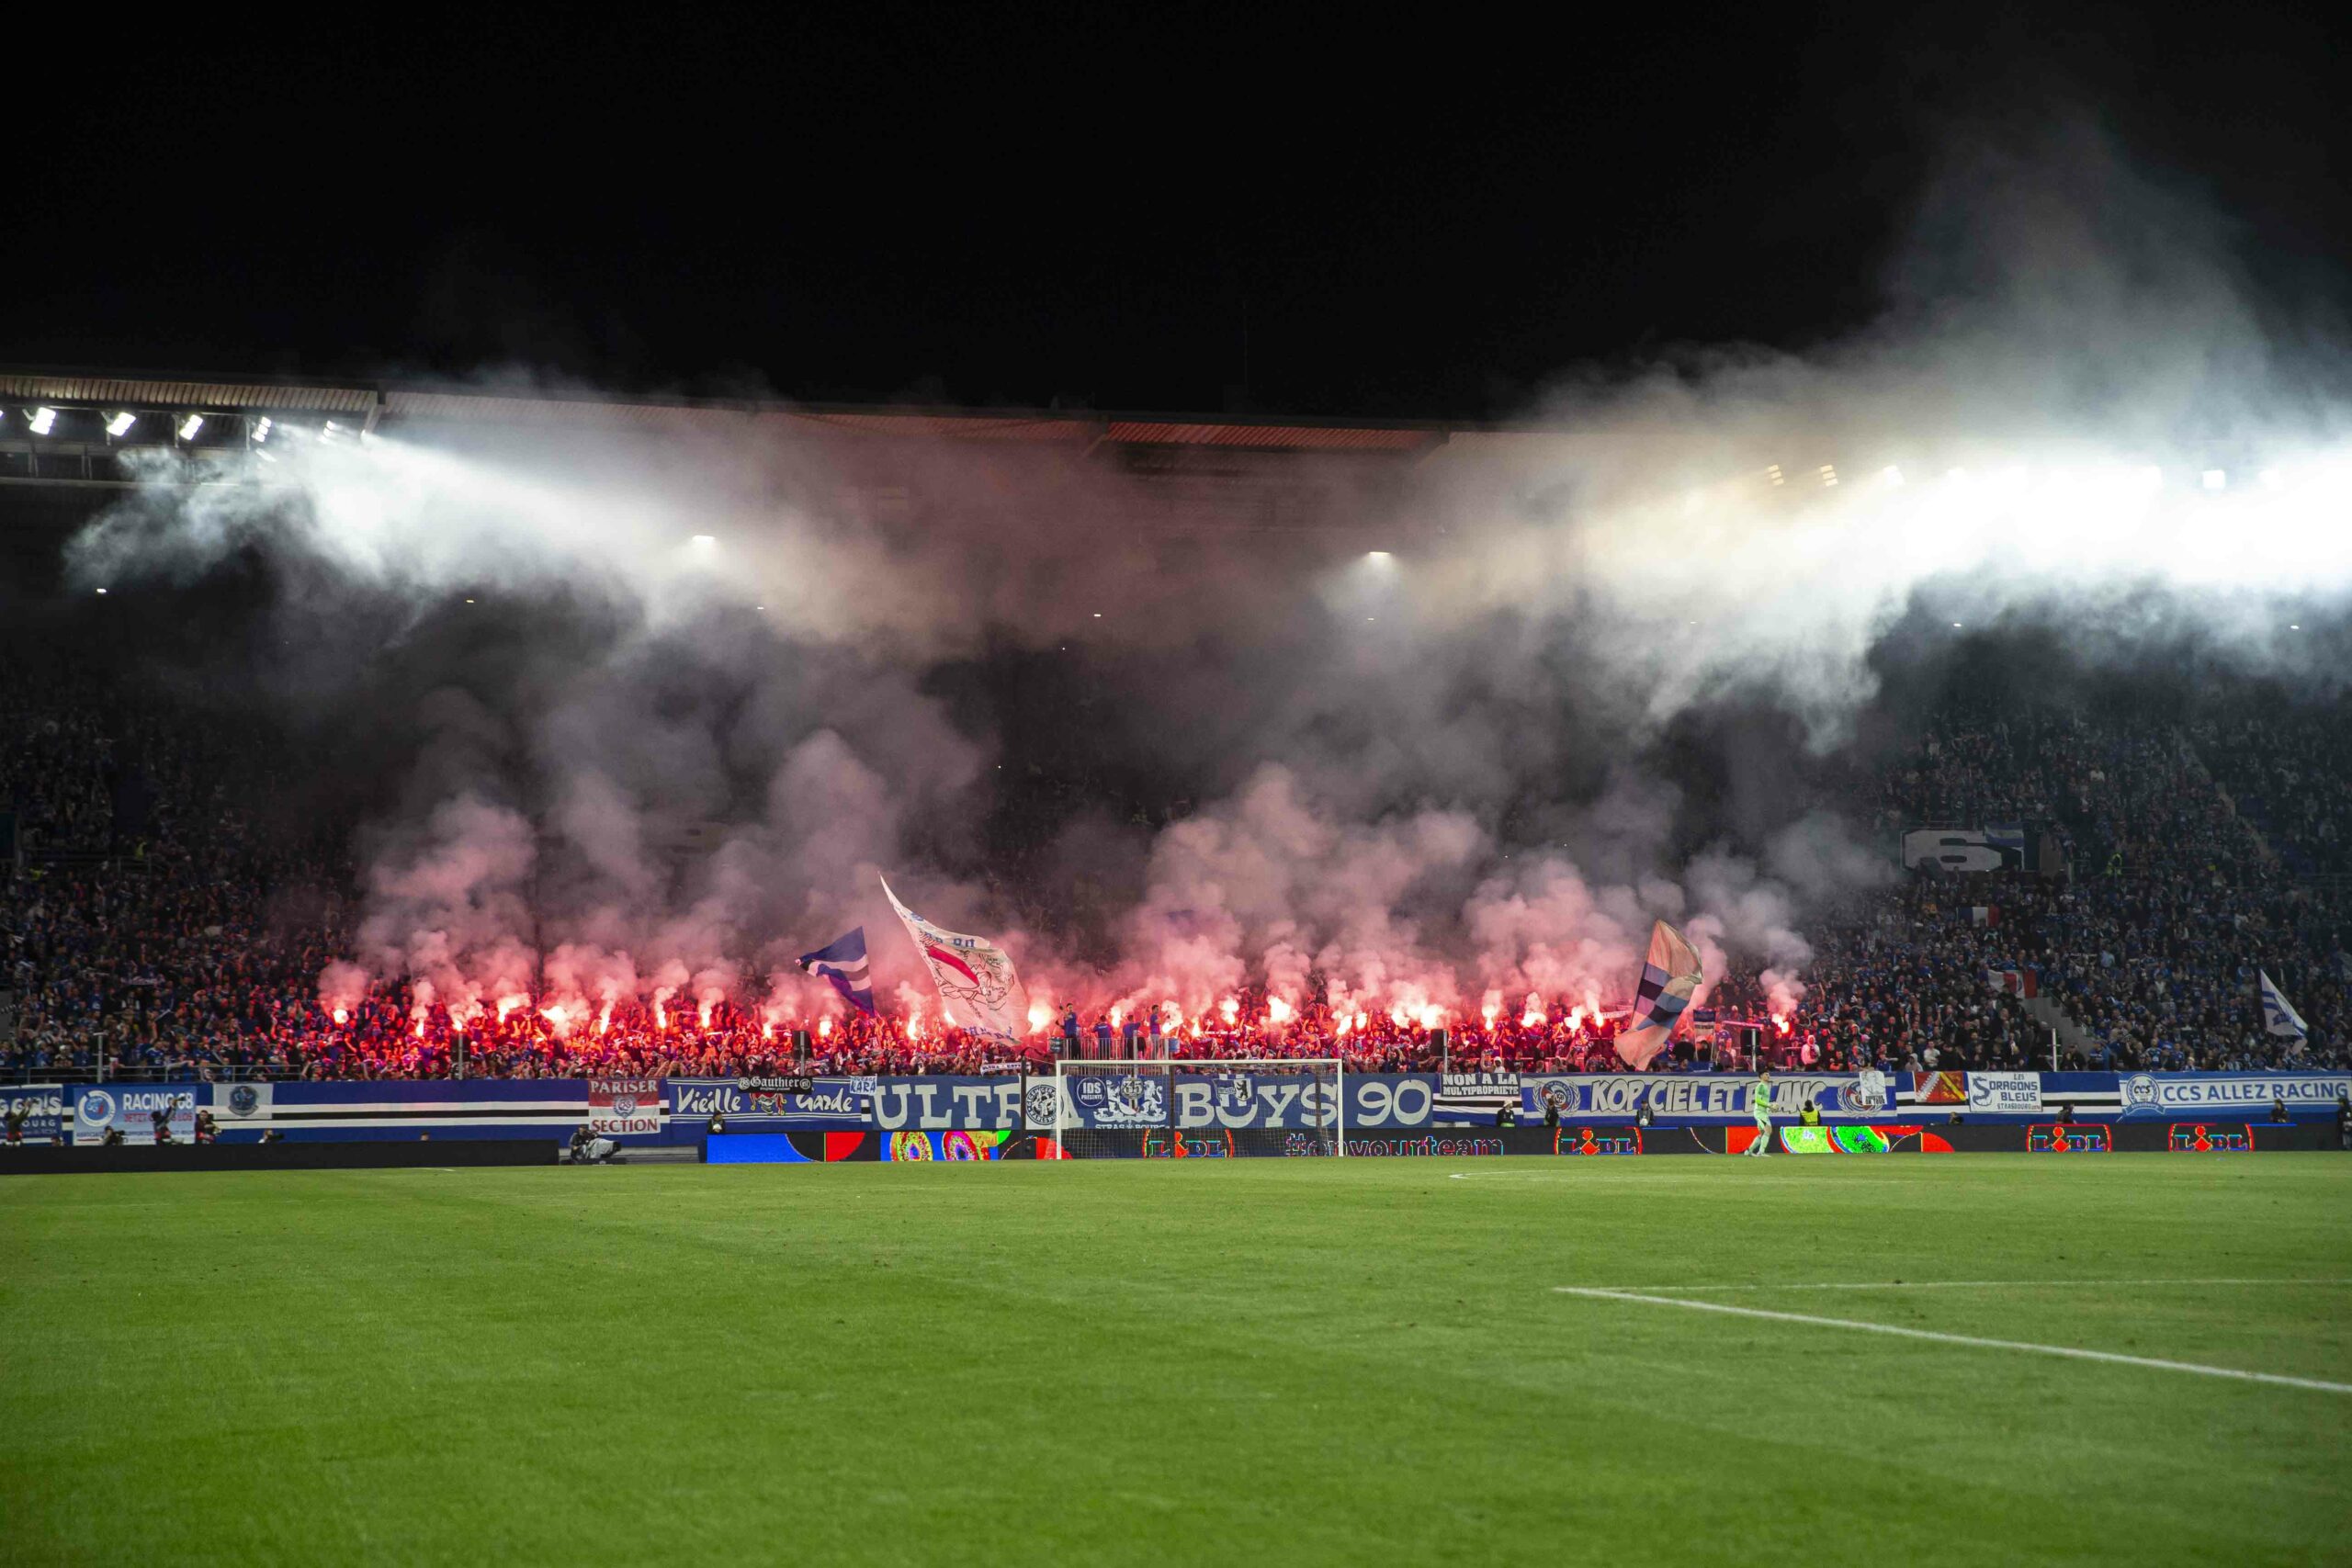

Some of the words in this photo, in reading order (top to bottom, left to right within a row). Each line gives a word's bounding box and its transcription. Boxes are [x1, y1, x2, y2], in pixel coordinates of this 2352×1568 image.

[751, 1077, 799, 1088] Gauthier
[1442, 1073, 1476, 1085] NON
[1482, 1073, 1493, 1084] A
[1498, 1073, 1518, 1084] LA
[591, 1079, 658, 1093] PARISER
[851, 1081, 876, 1092] KARA
[1083, 1083, 1101, 1093] IDS
[1123, 1080, 1142, 1093] 35
[1443, 1086, 1519, 1095] MULTIPROPRIETE
[1989, 1081, 2038, 1090] DRAGONS
[2133, 1085, 2151, 1094] CCS
[1590, 1078, 1645, 1112] KOP
[1649, 1080, 1702, 1112] CIEL
[1708, 1081, 1742, 1112] ET
[1745, 1081, 1827, 1114] BANC
[2000, 1092, 2037, 1101] BLEUS
[2164, 1086, 2201, 1101] CCS
[2207, 1084, 2267, 1100] ALLEZ
[2272, 1082, 2348, 1099] RACING
[1357, 1079, 1431, 1126] 90
[592, 1119, 658, 1132] SECTION
